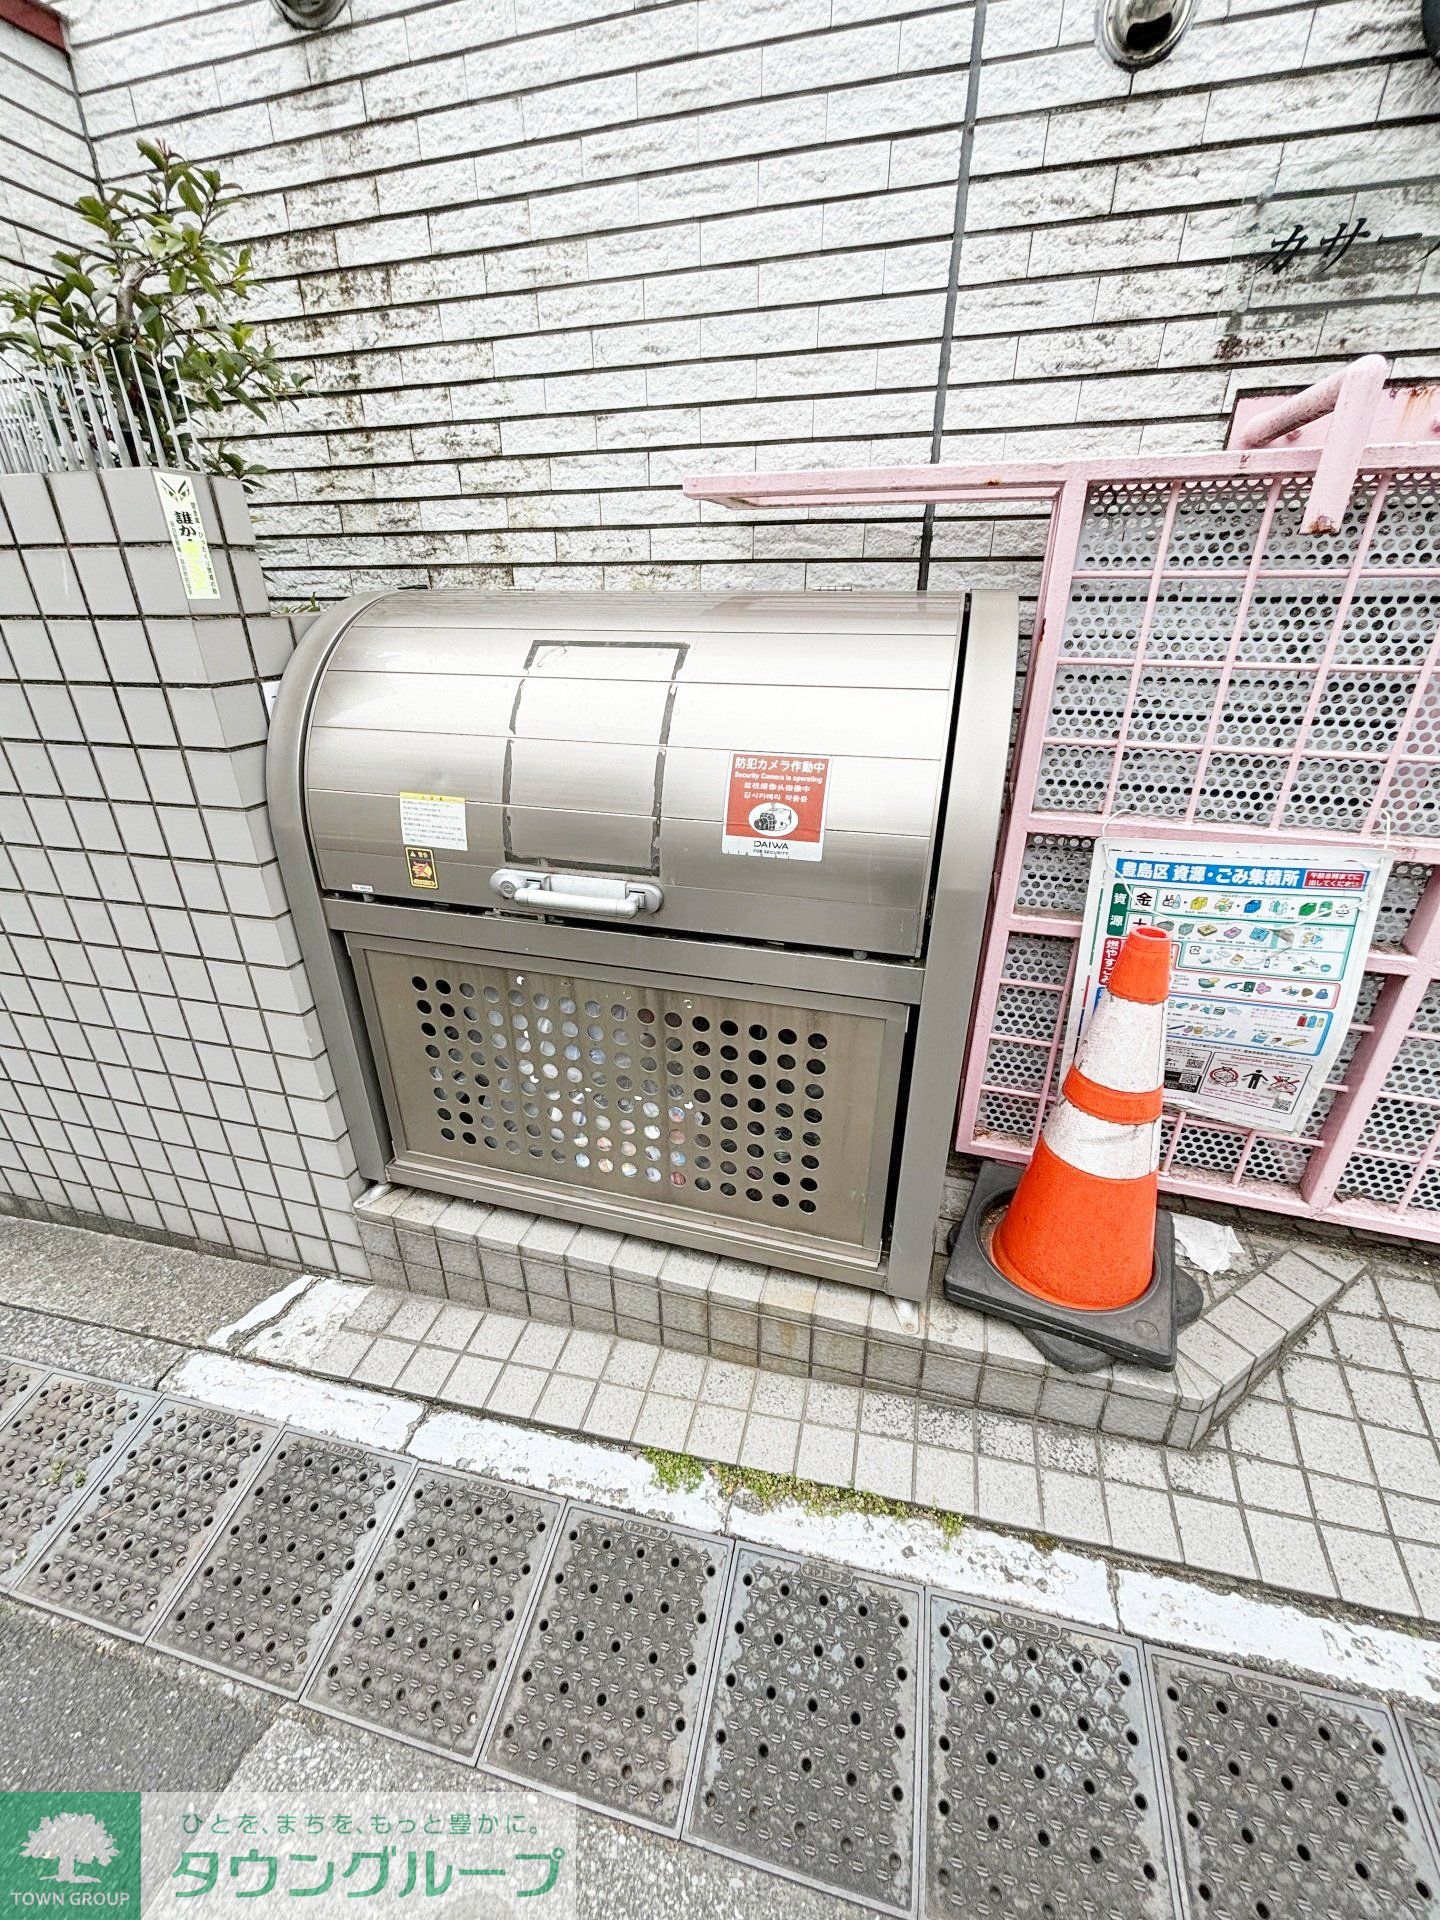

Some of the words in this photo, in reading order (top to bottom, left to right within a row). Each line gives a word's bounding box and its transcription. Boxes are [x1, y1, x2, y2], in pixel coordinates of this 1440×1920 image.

[1253, 218, 1440, 275] カサー
[735, 757, 825, 772] 防犯カメラ作動中
[734, 771, 760, 781] Security
[761, 773, 785, 781] Camera
[793, 776, 823, 785] operating
[754, 840, 789, 850] DAIWA
[1122, 861, 1170, 880] 豊島区
[1172, 864, 1300, 886] 資源・ごみ集積所
[1136, 891, 1153, 907] 金
[1110, 892, 1128, 927] 資源
